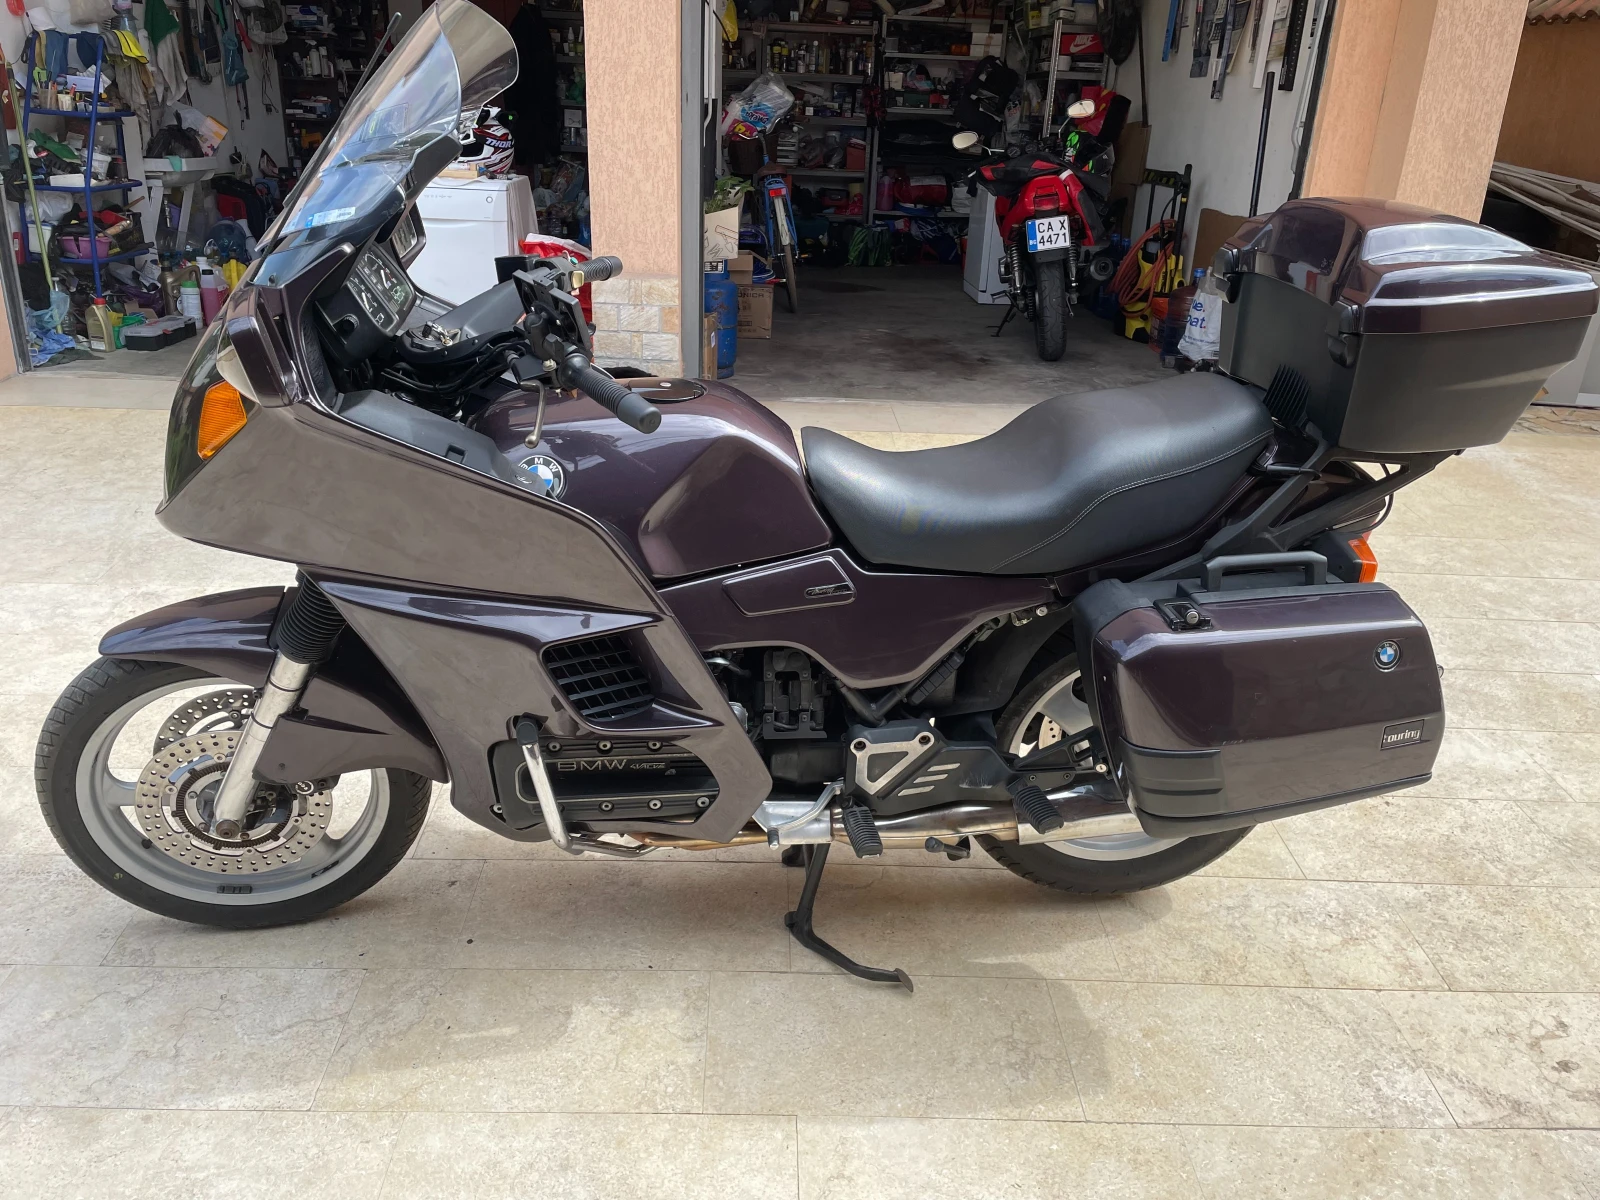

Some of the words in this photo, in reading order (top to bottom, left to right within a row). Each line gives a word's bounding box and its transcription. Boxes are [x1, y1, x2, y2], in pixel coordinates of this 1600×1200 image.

[1074, 34, 1094, 45] NIKE
[484, 137, 512, 148] THOR
[1037, 221, 1054, 234] CA
[1058, 219, 1067, 231] X
[1038, 232, 1067, 247] 4471
[557, 759, 627, 771] BMW
